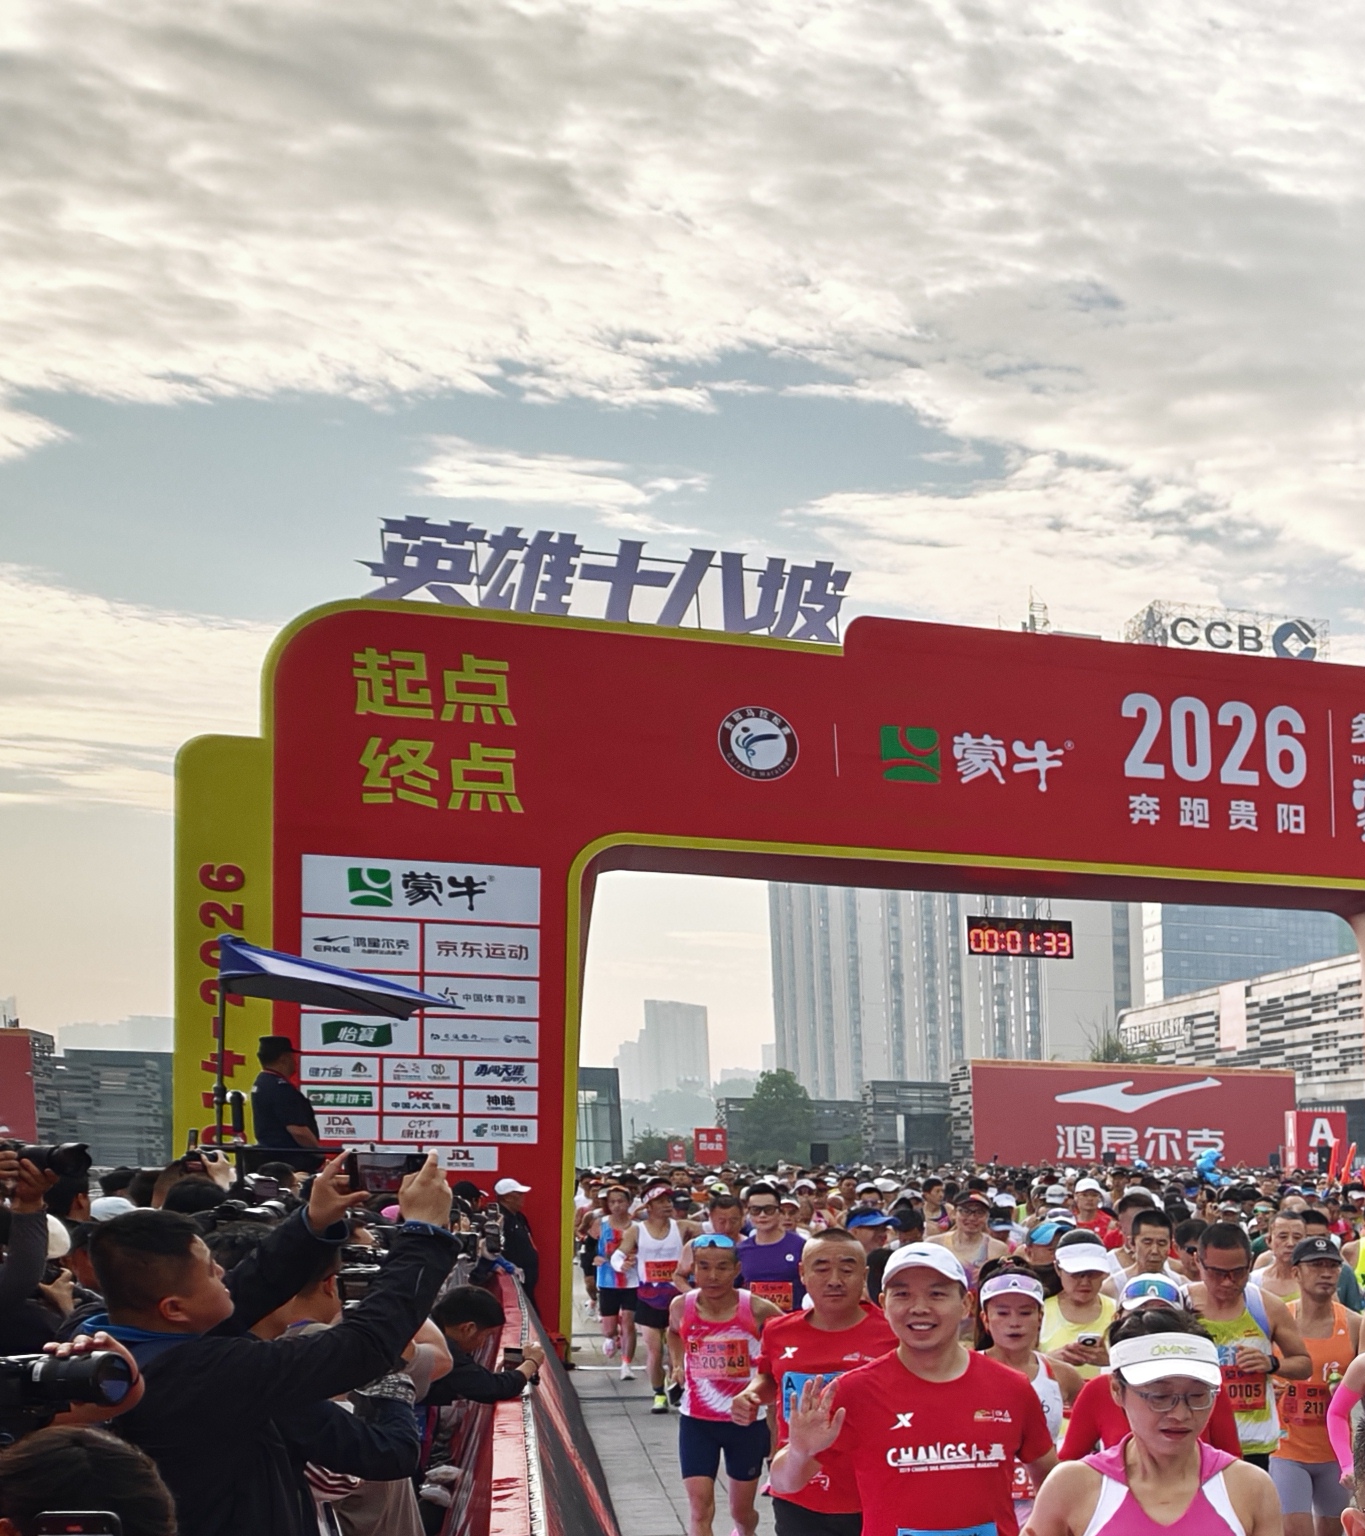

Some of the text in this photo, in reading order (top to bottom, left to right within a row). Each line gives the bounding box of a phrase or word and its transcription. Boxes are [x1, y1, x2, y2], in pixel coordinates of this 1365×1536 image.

[353, 514, 853, 643] 英雄十八坡
[1170, 617, 1264, 654] CCB
[352, 646, 518, 727] 起点
[1120, 692, 1308, 789] 2026
[357, 735, 525, 814] 终点
[952, 732, 1064, 793] 蒙牛
[1129, 793, 1306, 834] 奔跑贵阳
[402, 871, 487, 911] 蒙牛
[435, 940, 529, 961] 京东运动
[969, 926, 1073, 958] 00:01:33
[326, 1116, 353, 1126] JDA
[1308, 1117, 1335, 1148] A
[447, 1149, 475, 1161] JDL
[1055, 1123, 1226, 1163] 鸿星尔克
[784, 1376, 797, 1391] A
